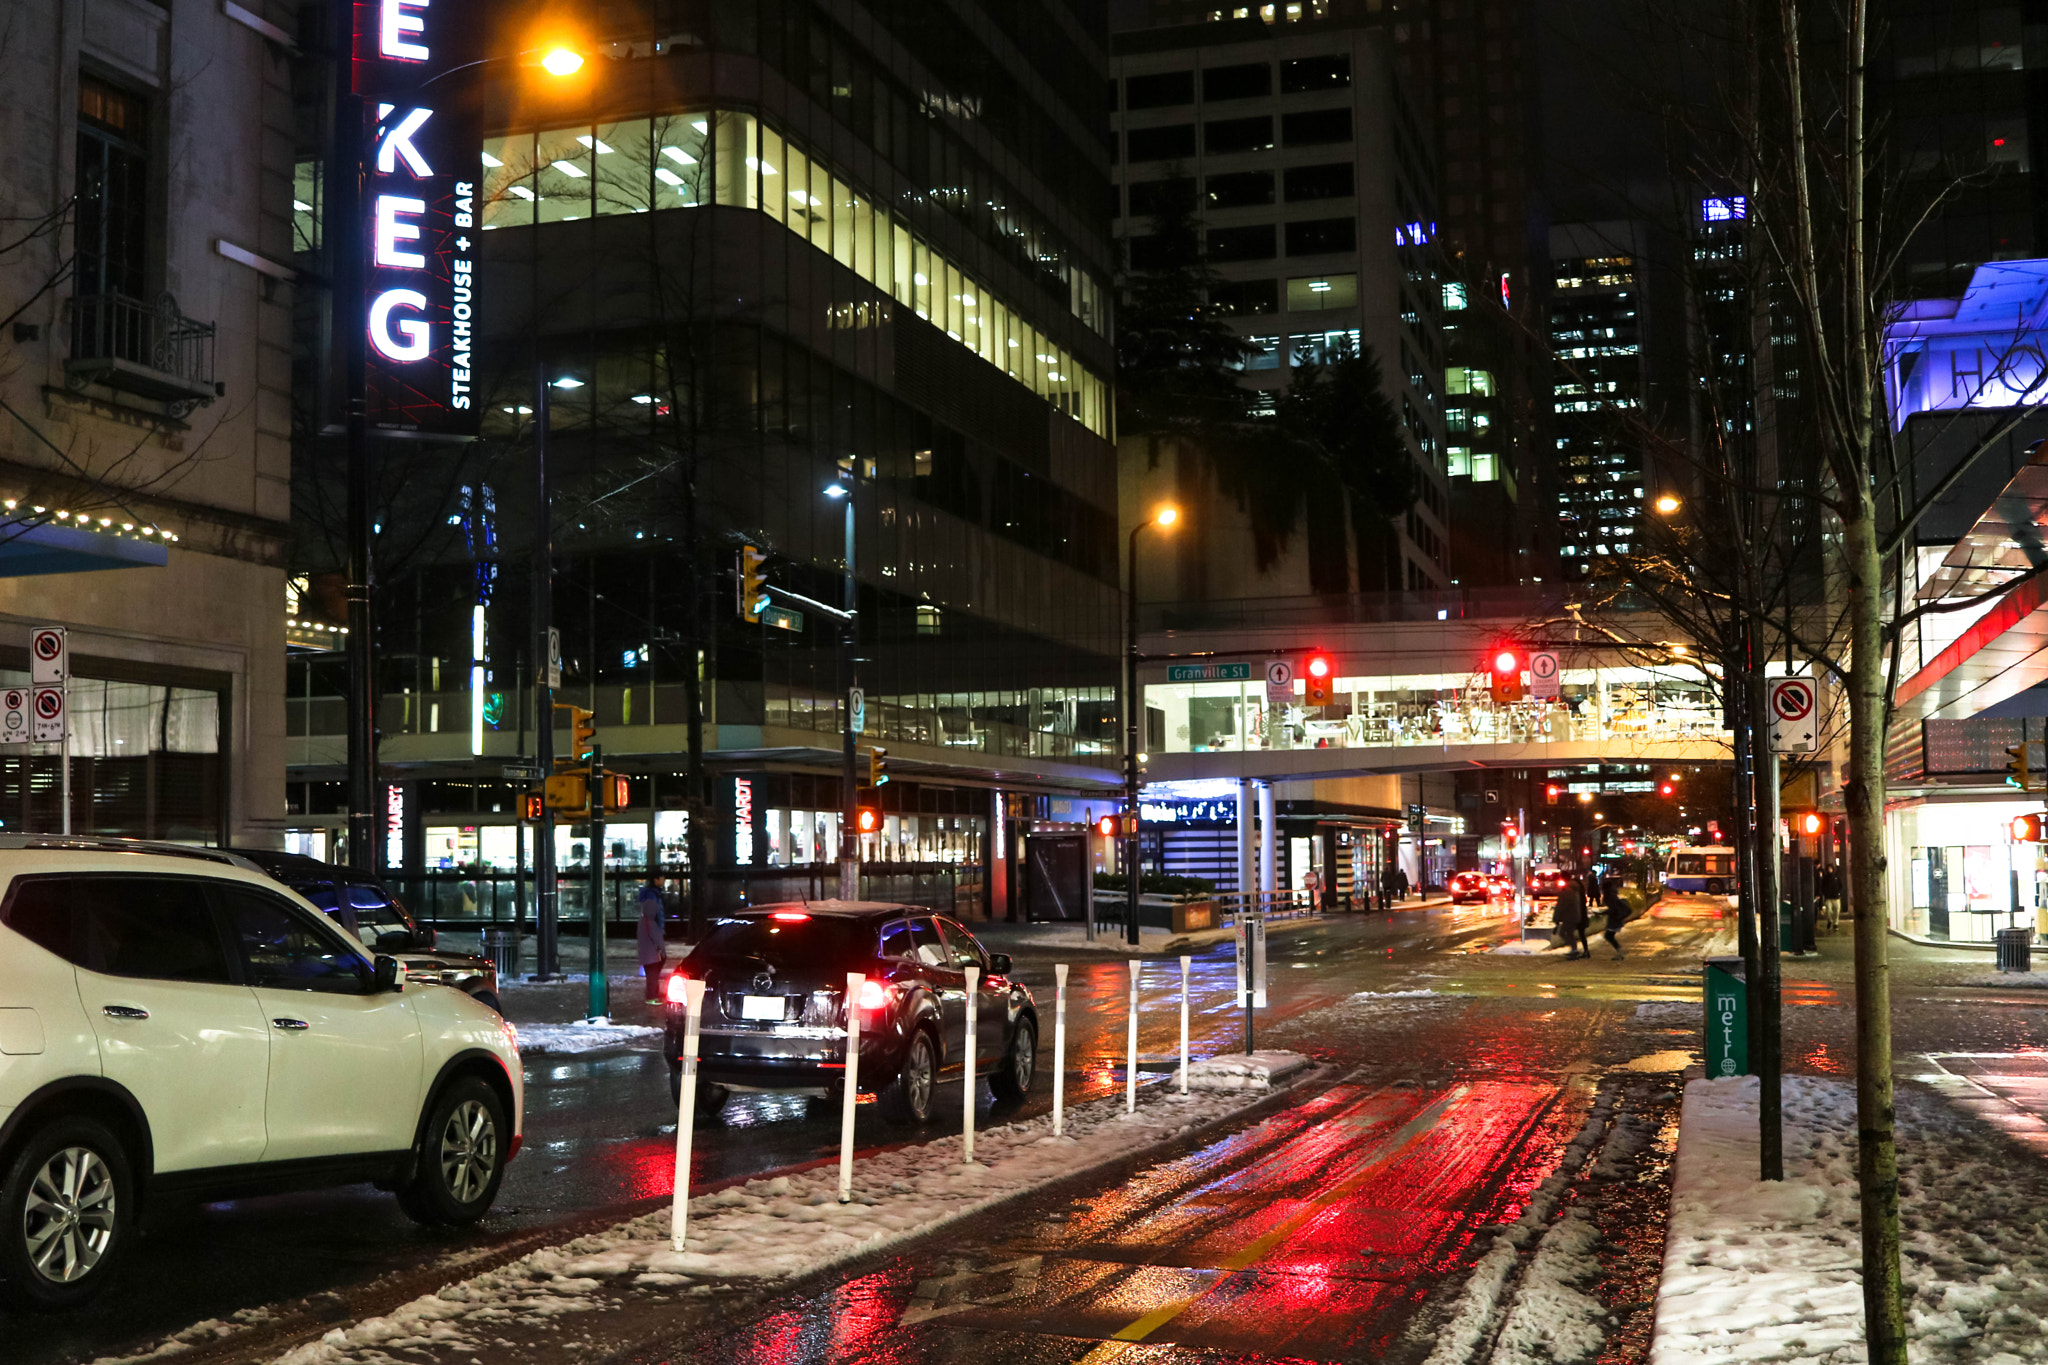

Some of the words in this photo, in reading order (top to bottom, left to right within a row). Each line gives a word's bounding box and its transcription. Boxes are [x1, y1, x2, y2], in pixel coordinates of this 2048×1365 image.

[368, 102, 434, 362] KEG
[455, 181, 473, 229] BAR
[452, 260, 473, 411] STEAKHOUSE
[1174, 668, 1227, 680] Granville
[1232, 666, 1244, 678] St
